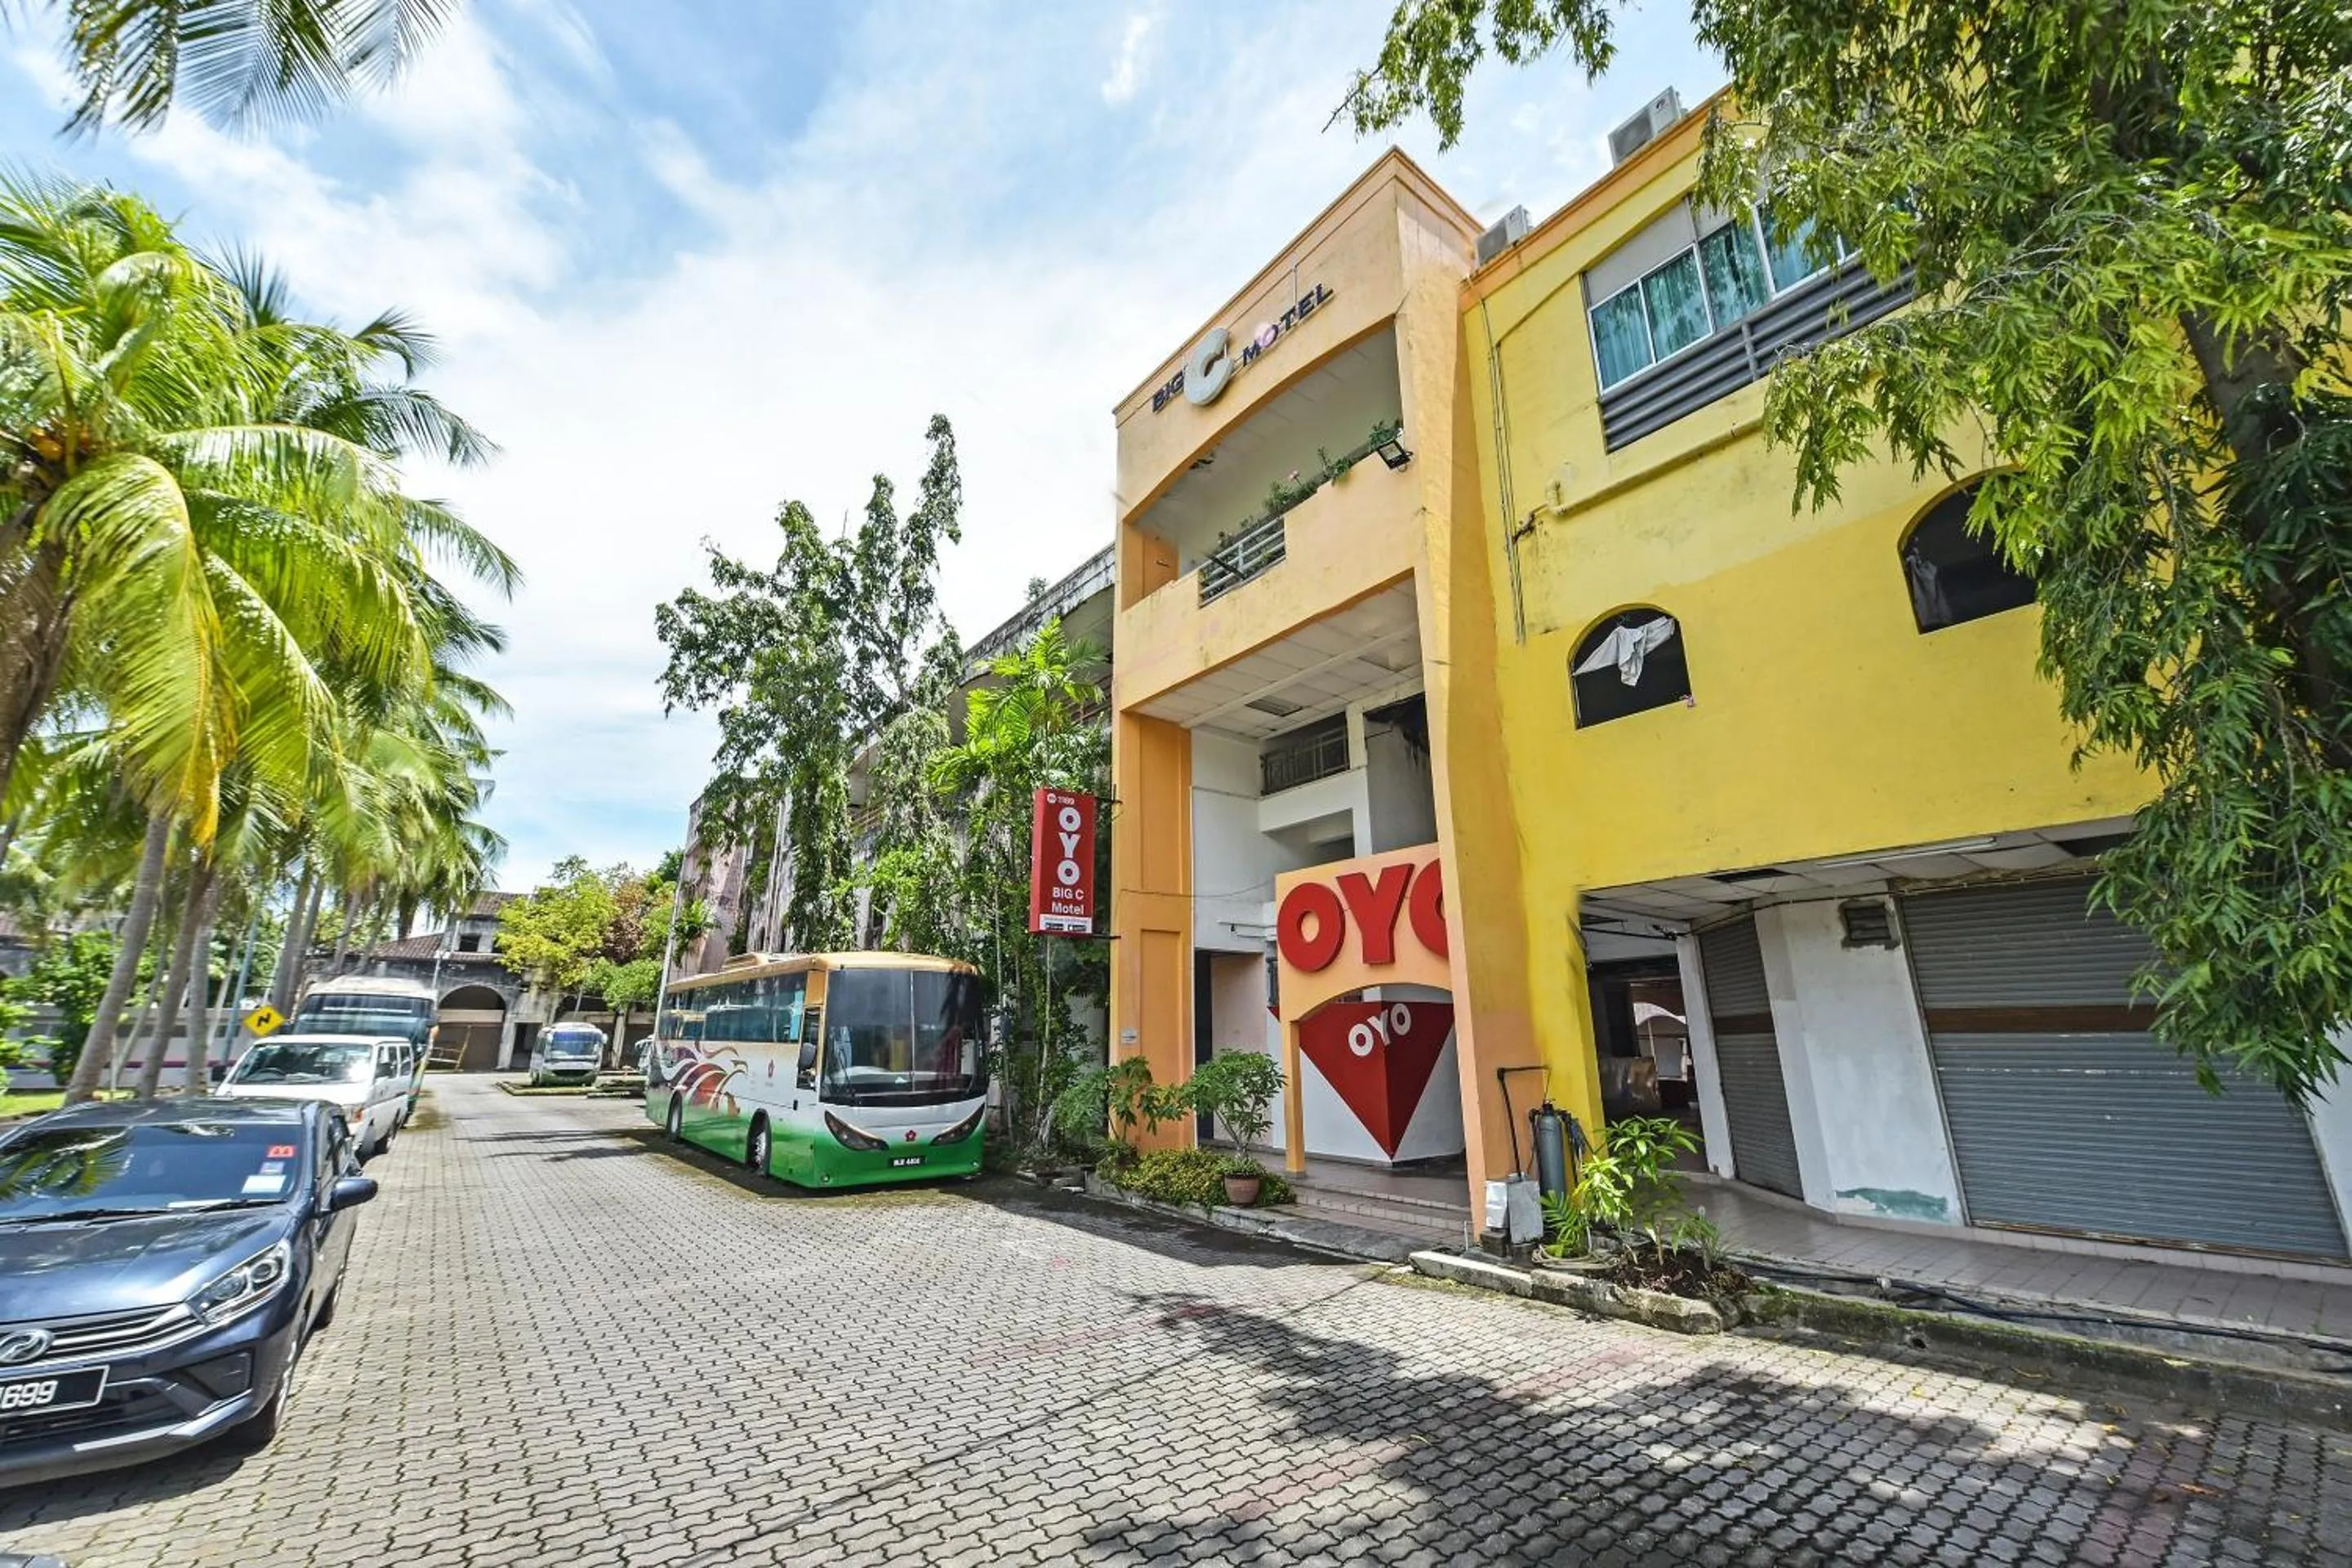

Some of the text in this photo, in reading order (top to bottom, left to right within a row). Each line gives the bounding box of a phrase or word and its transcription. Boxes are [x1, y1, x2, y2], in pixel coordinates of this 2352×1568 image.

[1152, 283, 1334, 412] BIG C MOTEL
[1057, 807, 1081, 885] OYO
[1051, 901, 1085, 915] Motel
[1052, 887, 1085, 900] BIG C
[1348, 1003, 1412, 1057] OYO
[0, 1380, 59, 1409] 699
